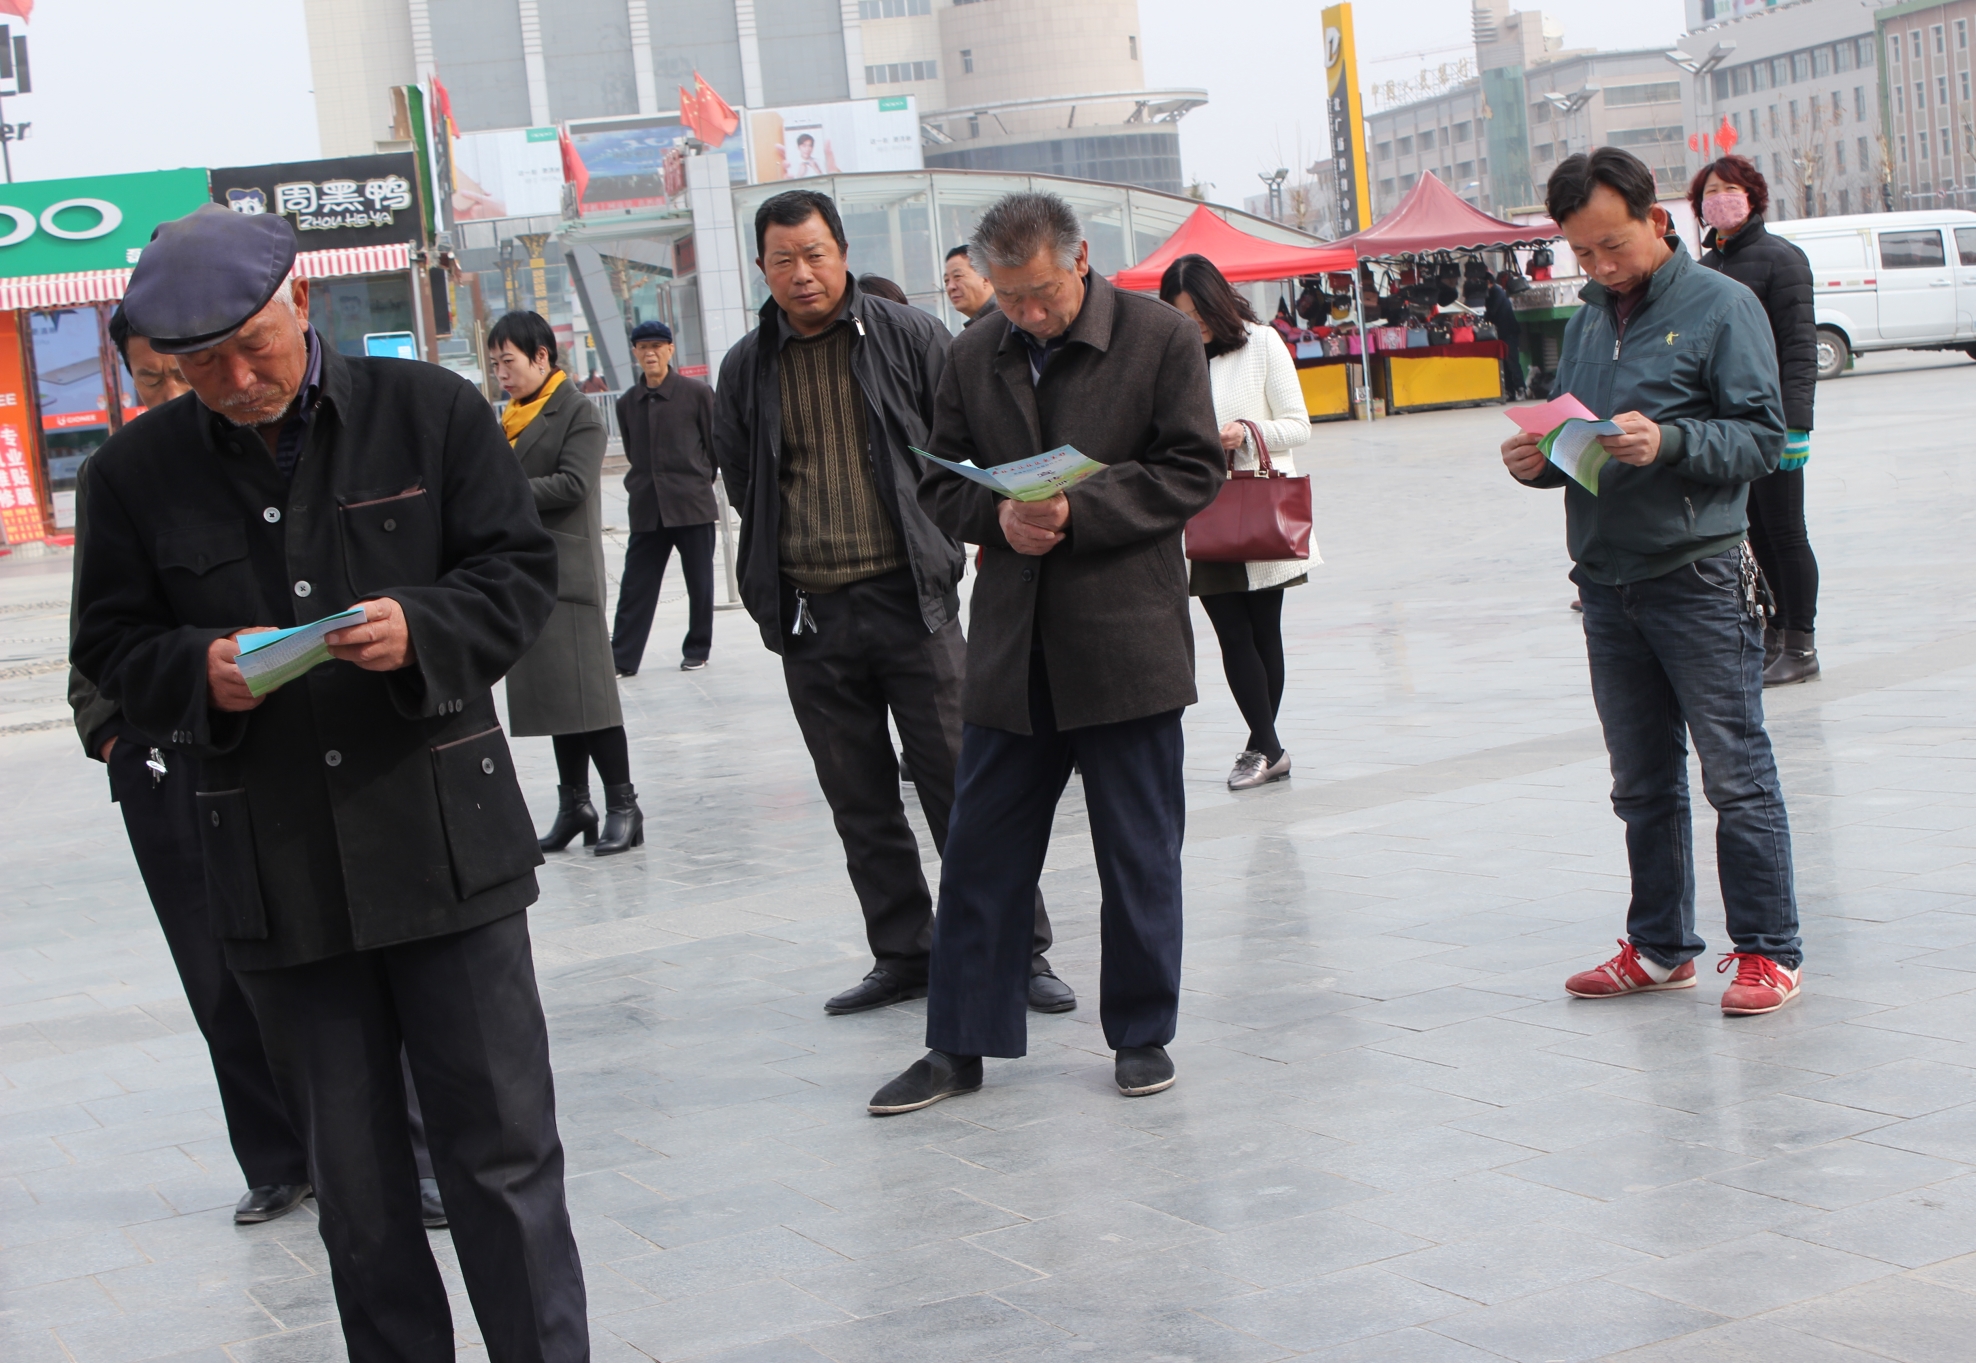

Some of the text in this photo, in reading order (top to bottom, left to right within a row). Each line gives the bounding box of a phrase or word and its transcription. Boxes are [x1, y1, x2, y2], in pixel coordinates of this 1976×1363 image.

[275, 177, 411, 214] 周黑鸭
[299, 215, 343, 229] ZHOU
[369, 210, 392, 224] YA
